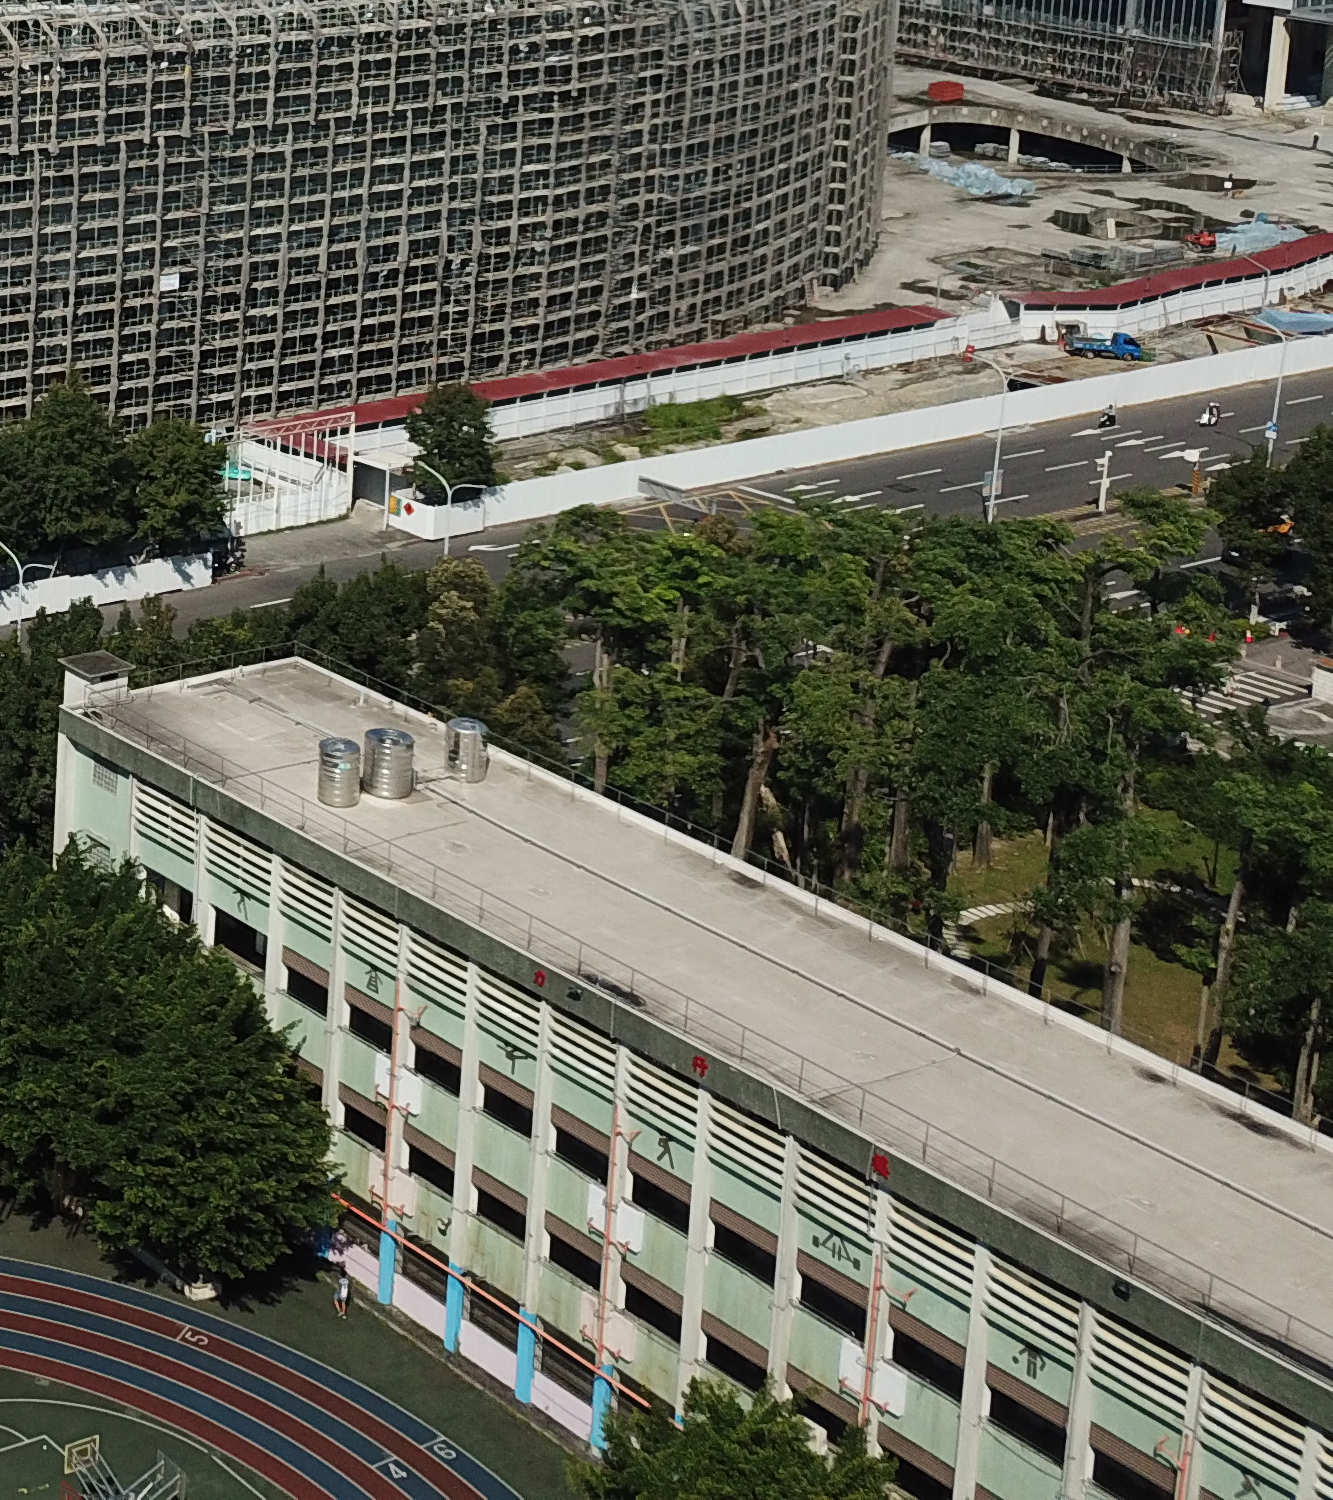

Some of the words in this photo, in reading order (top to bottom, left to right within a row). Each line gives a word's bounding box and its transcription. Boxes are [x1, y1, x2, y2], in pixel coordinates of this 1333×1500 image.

[185, 1330, 209, 1347] 5
[433, 1443, 457, 1460] 6
[388, 1462, 408, 1479] 4
